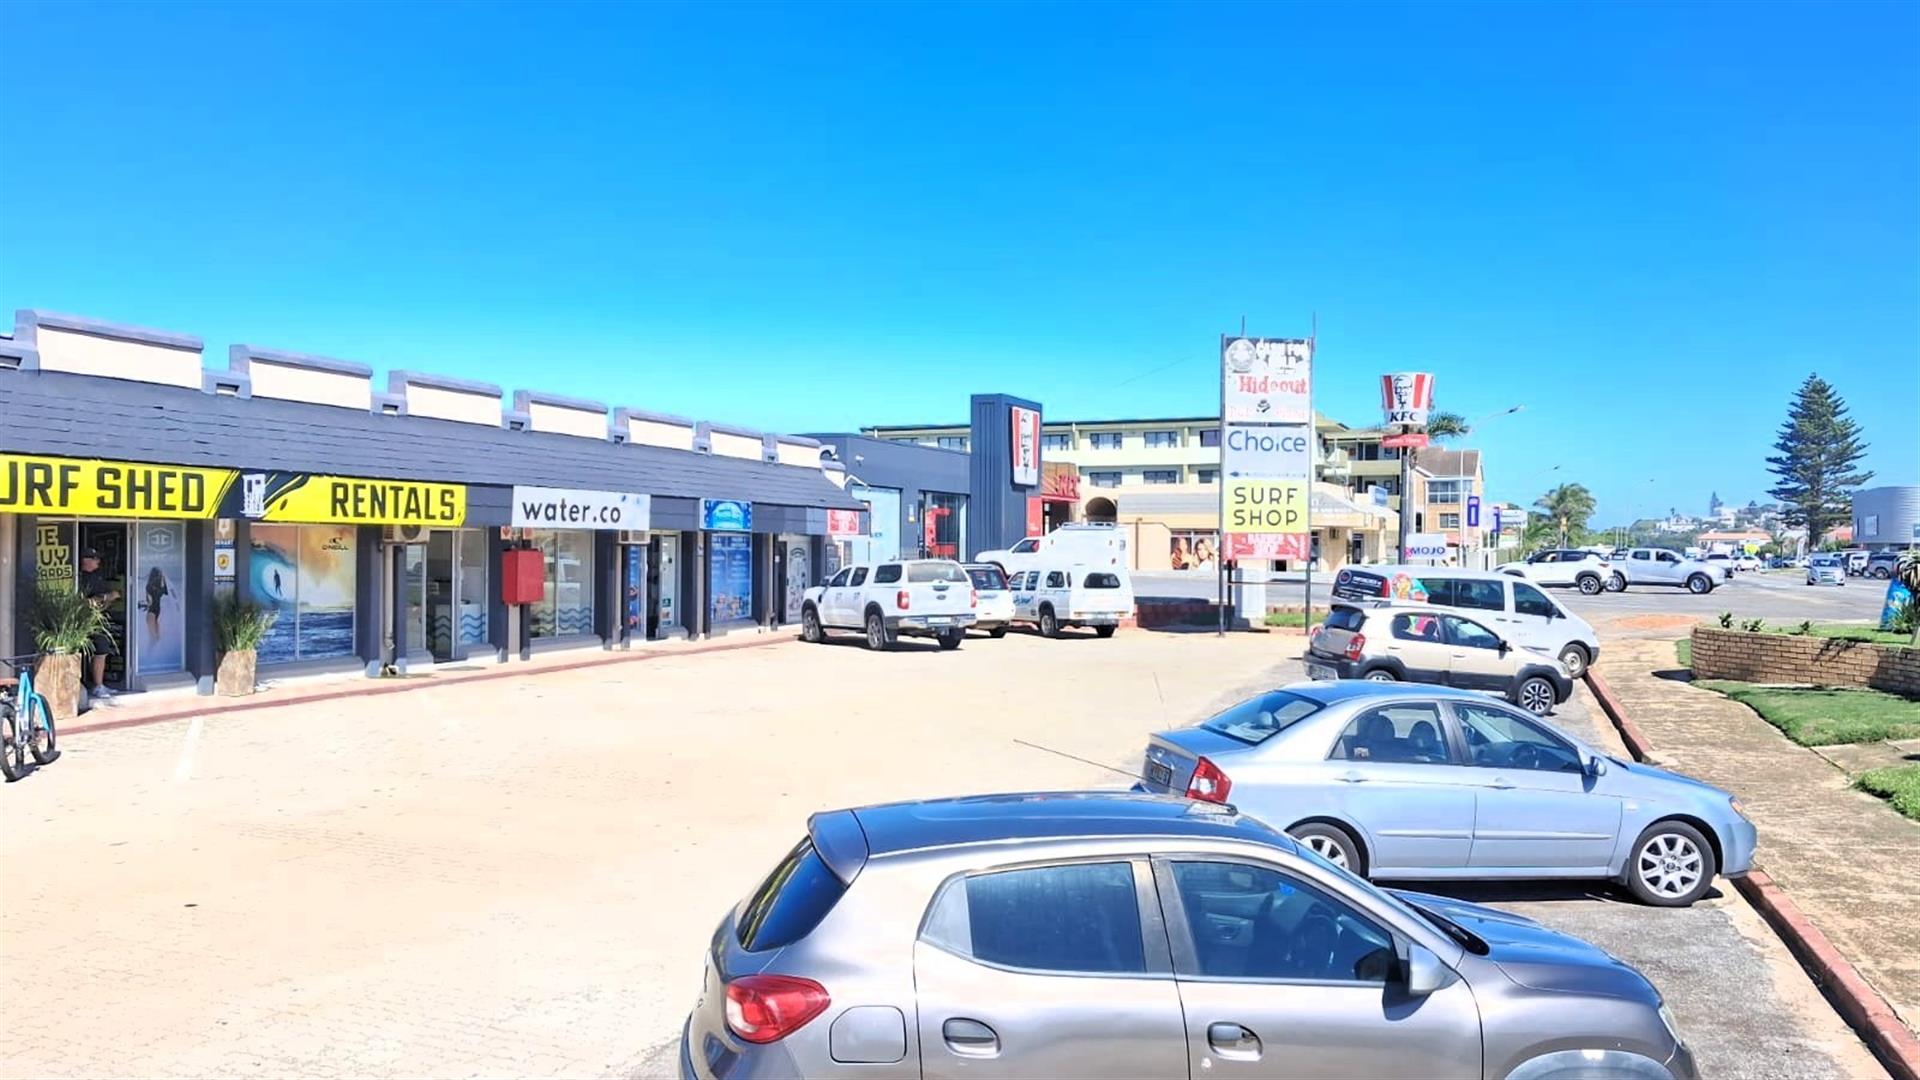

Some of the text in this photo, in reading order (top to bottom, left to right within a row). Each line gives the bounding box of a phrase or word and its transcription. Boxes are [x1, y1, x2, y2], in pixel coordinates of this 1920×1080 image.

[1238, 375, 1307, 394] Hideout
[1390, 411, 1418, 422] KFC
[1227, 430, 1307, 452] Choice
[96, 467, 205, 512] SHED
[1233, 487, 1298, 504] SURF
[330, 482, 455, 521] RENTALS
[522, 498, 621, 523] water.co
[1233, 509, 1298, 526] SHOP
